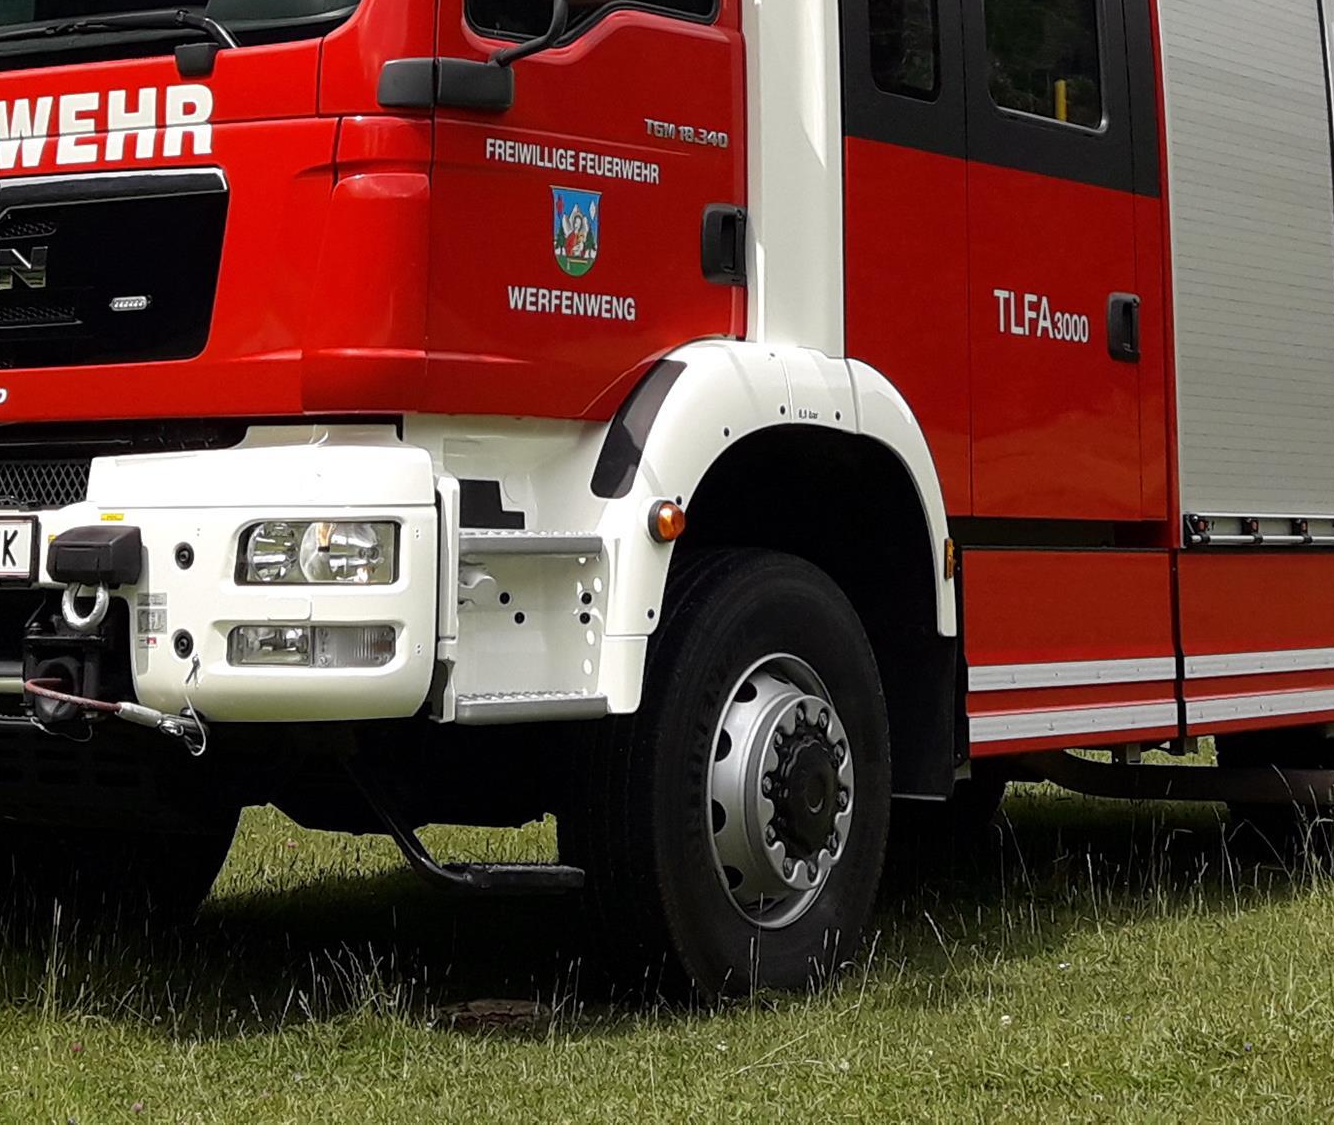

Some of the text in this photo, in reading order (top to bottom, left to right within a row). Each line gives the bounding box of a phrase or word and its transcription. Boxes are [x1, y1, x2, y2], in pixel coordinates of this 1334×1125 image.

[644, 118, 729, 149] TGM 18.340
[485, 138, 660, 184] FREIWILLIGE FEUERWEHR
[507, 285, 636, 322] WERFENWENG
